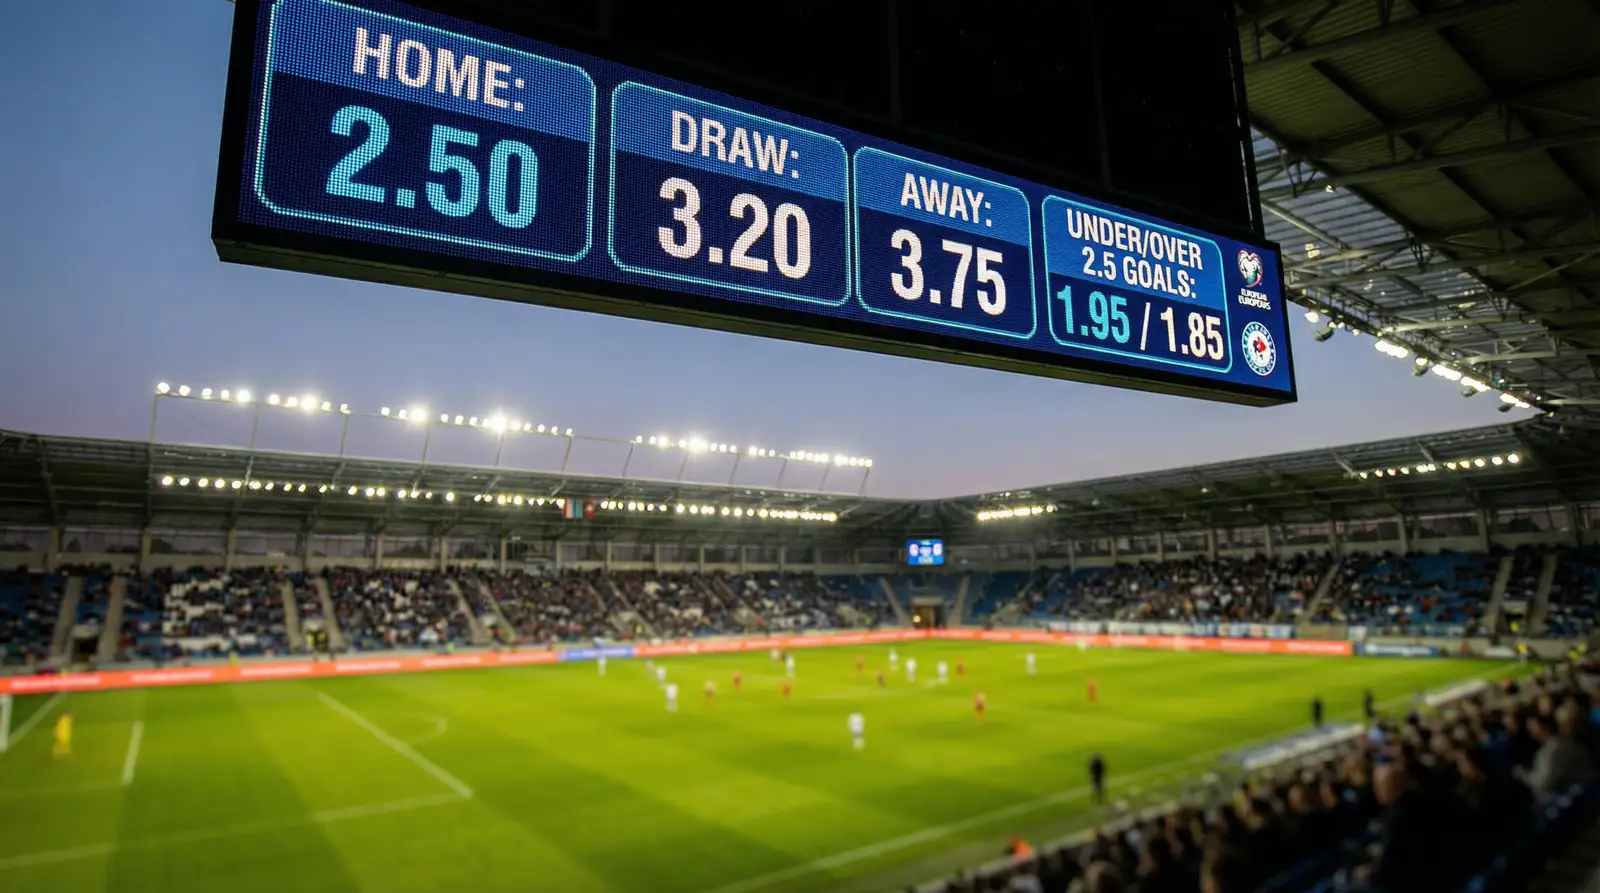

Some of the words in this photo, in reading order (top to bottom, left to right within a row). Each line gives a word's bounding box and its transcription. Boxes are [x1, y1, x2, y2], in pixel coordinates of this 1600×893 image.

[352, 27, 525, 112] HOME:
[325, 105, 539, 229] 2.50
[671, 110, 800, 180] DRAW:
[657, 176, 811, 280] 3.20
[900, 172, 992, 227] AWAY:
[890, 229, 1007, 316] 3.75
[1066, 208, 1203, 271] UNDER/OVER
[1082, 247, 1117, 281] 2.5
[1122, 257, 1197, 299] GOALS:
[1057, 285, 1131, 344] 1.95
[1139, 302, 1151, 351] /
[1160, 306, 1224, 361] 1.85
